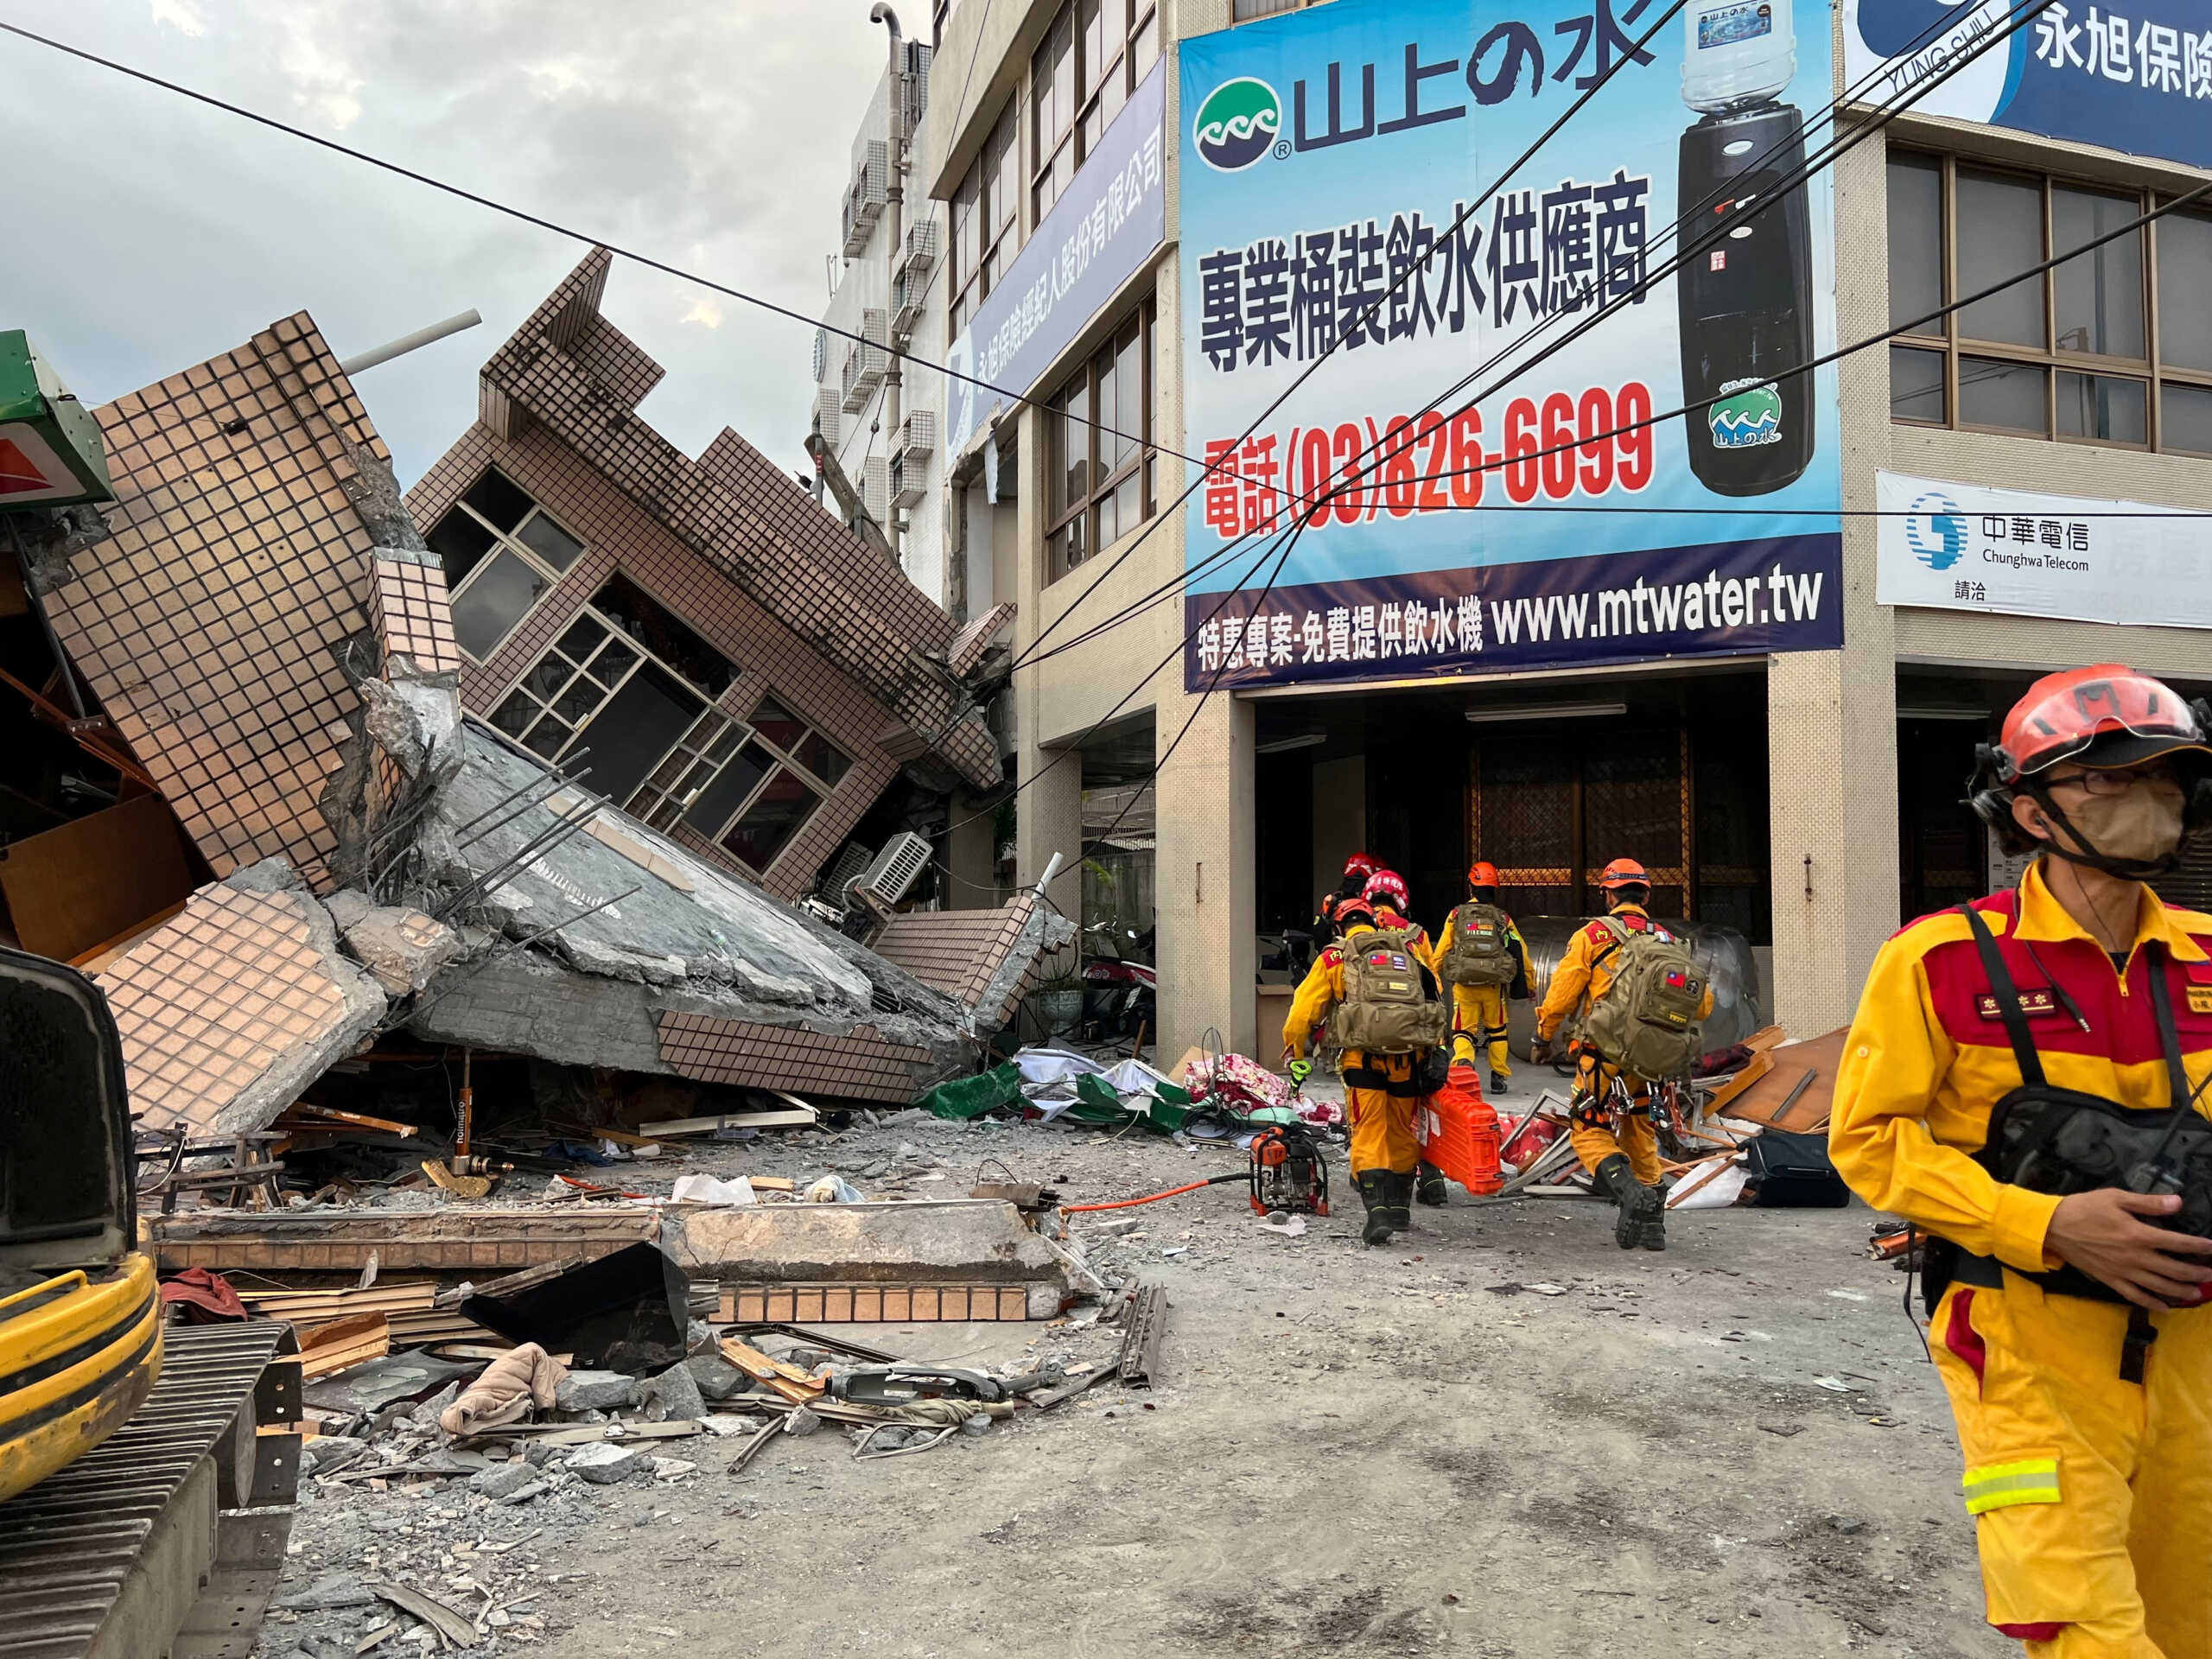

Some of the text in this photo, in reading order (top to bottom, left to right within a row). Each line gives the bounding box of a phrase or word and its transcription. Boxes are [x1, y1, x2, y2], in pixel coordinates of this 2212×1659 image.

[1294, 0, 1657, 153] 山上の水
[1885, 47, 1951, 93] YUNG
[977, 126, 1161, 395] 永旭保險經紀人股份有限公司
[1198, 169, 1649, 373] 專業桶裝飲水供應商
[1205, 383, 1654, 537] 電話 (03)826-6699
[1982, 515, 2089, 551] 中華電信
[1982, 549, 2089, 571] Chunghwa Telecom
[1491, 563, 1823, 645] www.mtwater.tw
[1954, 580, 1986, 601] 請洽
[456, 1101, 466, 1144] holmatro
